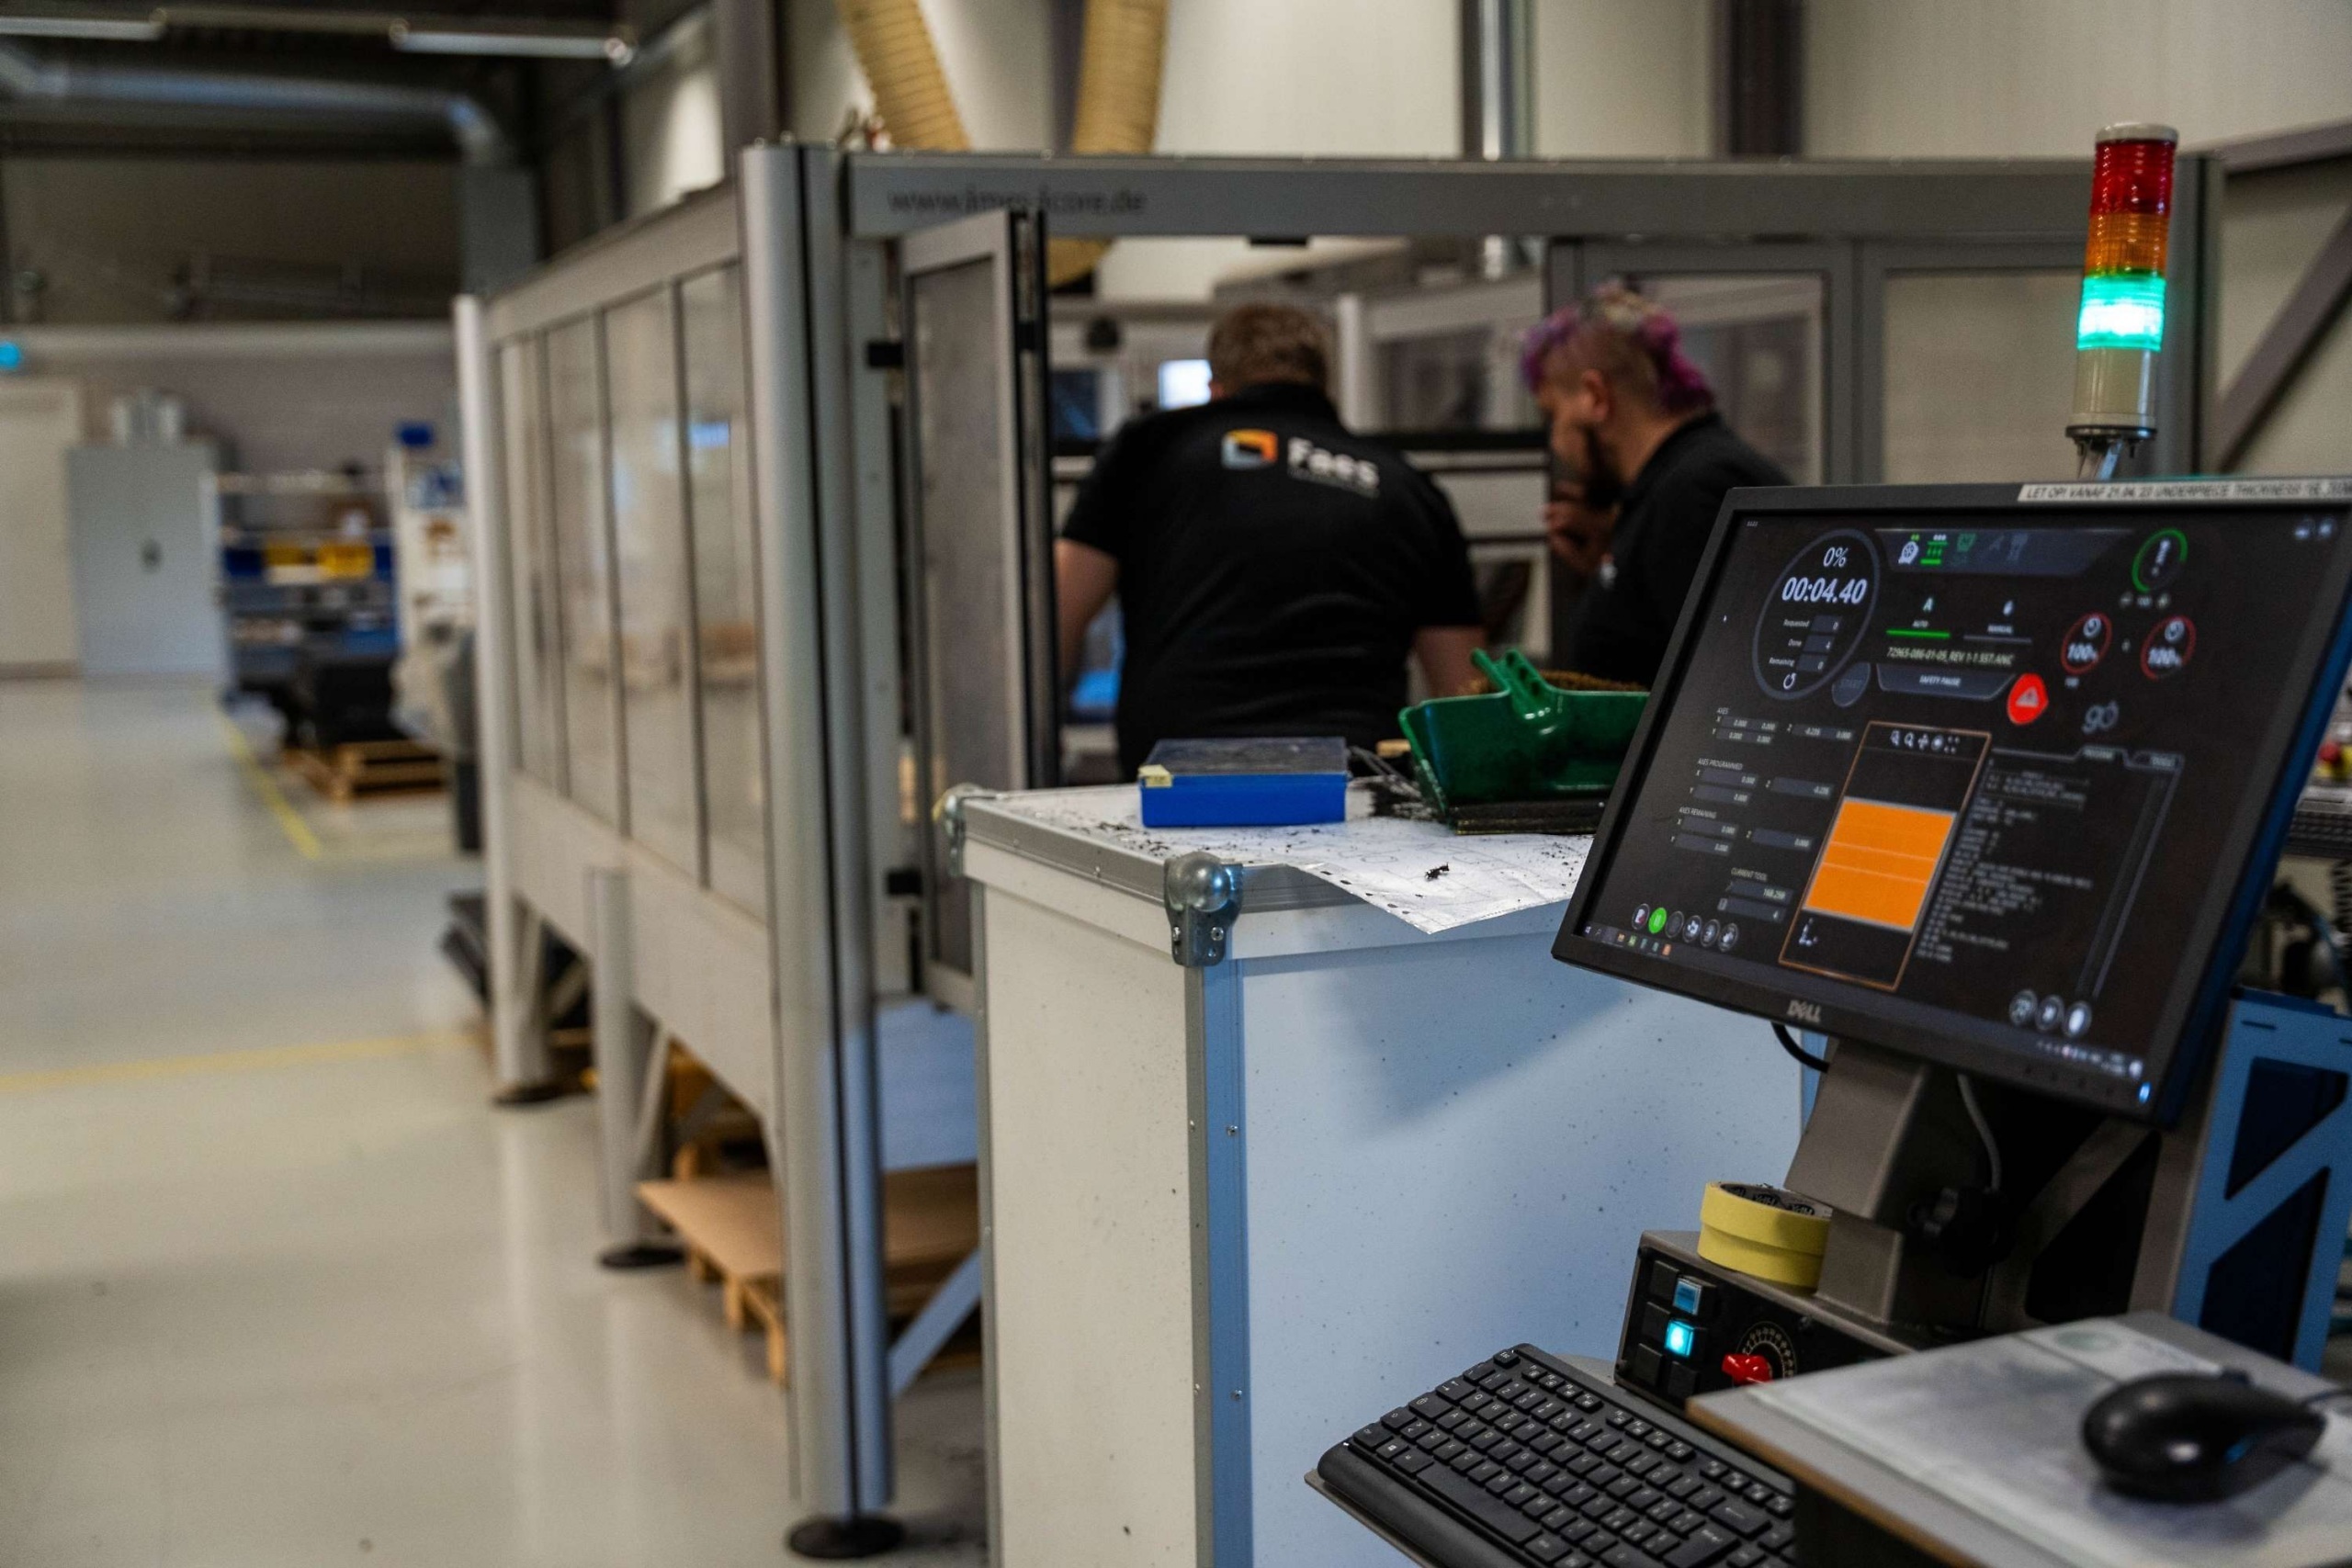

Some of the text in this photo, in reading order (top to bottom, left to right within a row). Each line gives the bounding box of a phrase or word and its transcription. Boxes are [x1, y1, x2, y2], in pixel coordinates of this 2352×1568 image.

[1824, 547, 1849, 567] 0%
[1781, 577, 1868, 604] 00:04.40
[1788, 638, 1802, 648] Done
[1769, 657, 1795, 668] Remaining
[1786, 999, 1821, 1023] DELL
